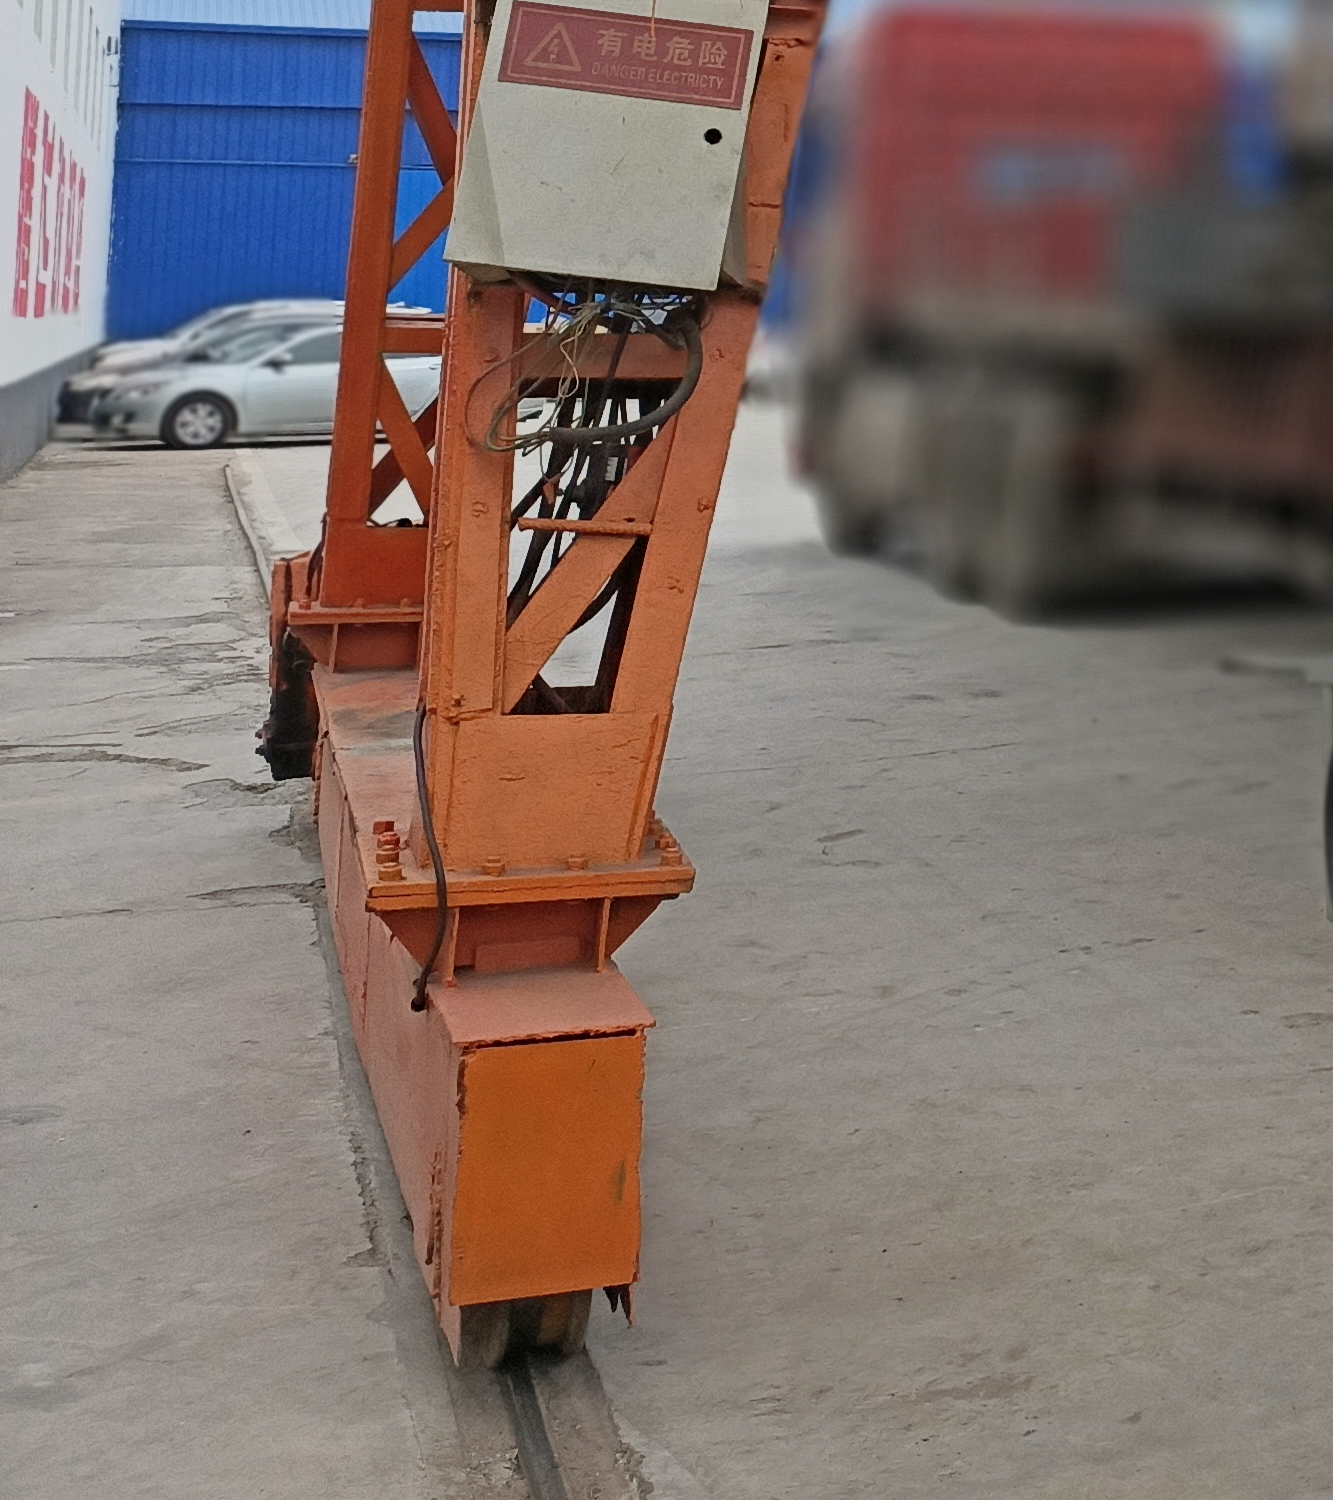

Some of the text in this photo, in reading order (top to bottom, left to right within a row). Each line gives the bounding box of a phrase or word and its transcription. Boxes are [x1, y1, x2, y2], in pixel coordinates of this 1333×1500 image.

[597, 27, 728, 69] 有电危险
[592, 62, 725, 89] DANGER ELECTRICTY
